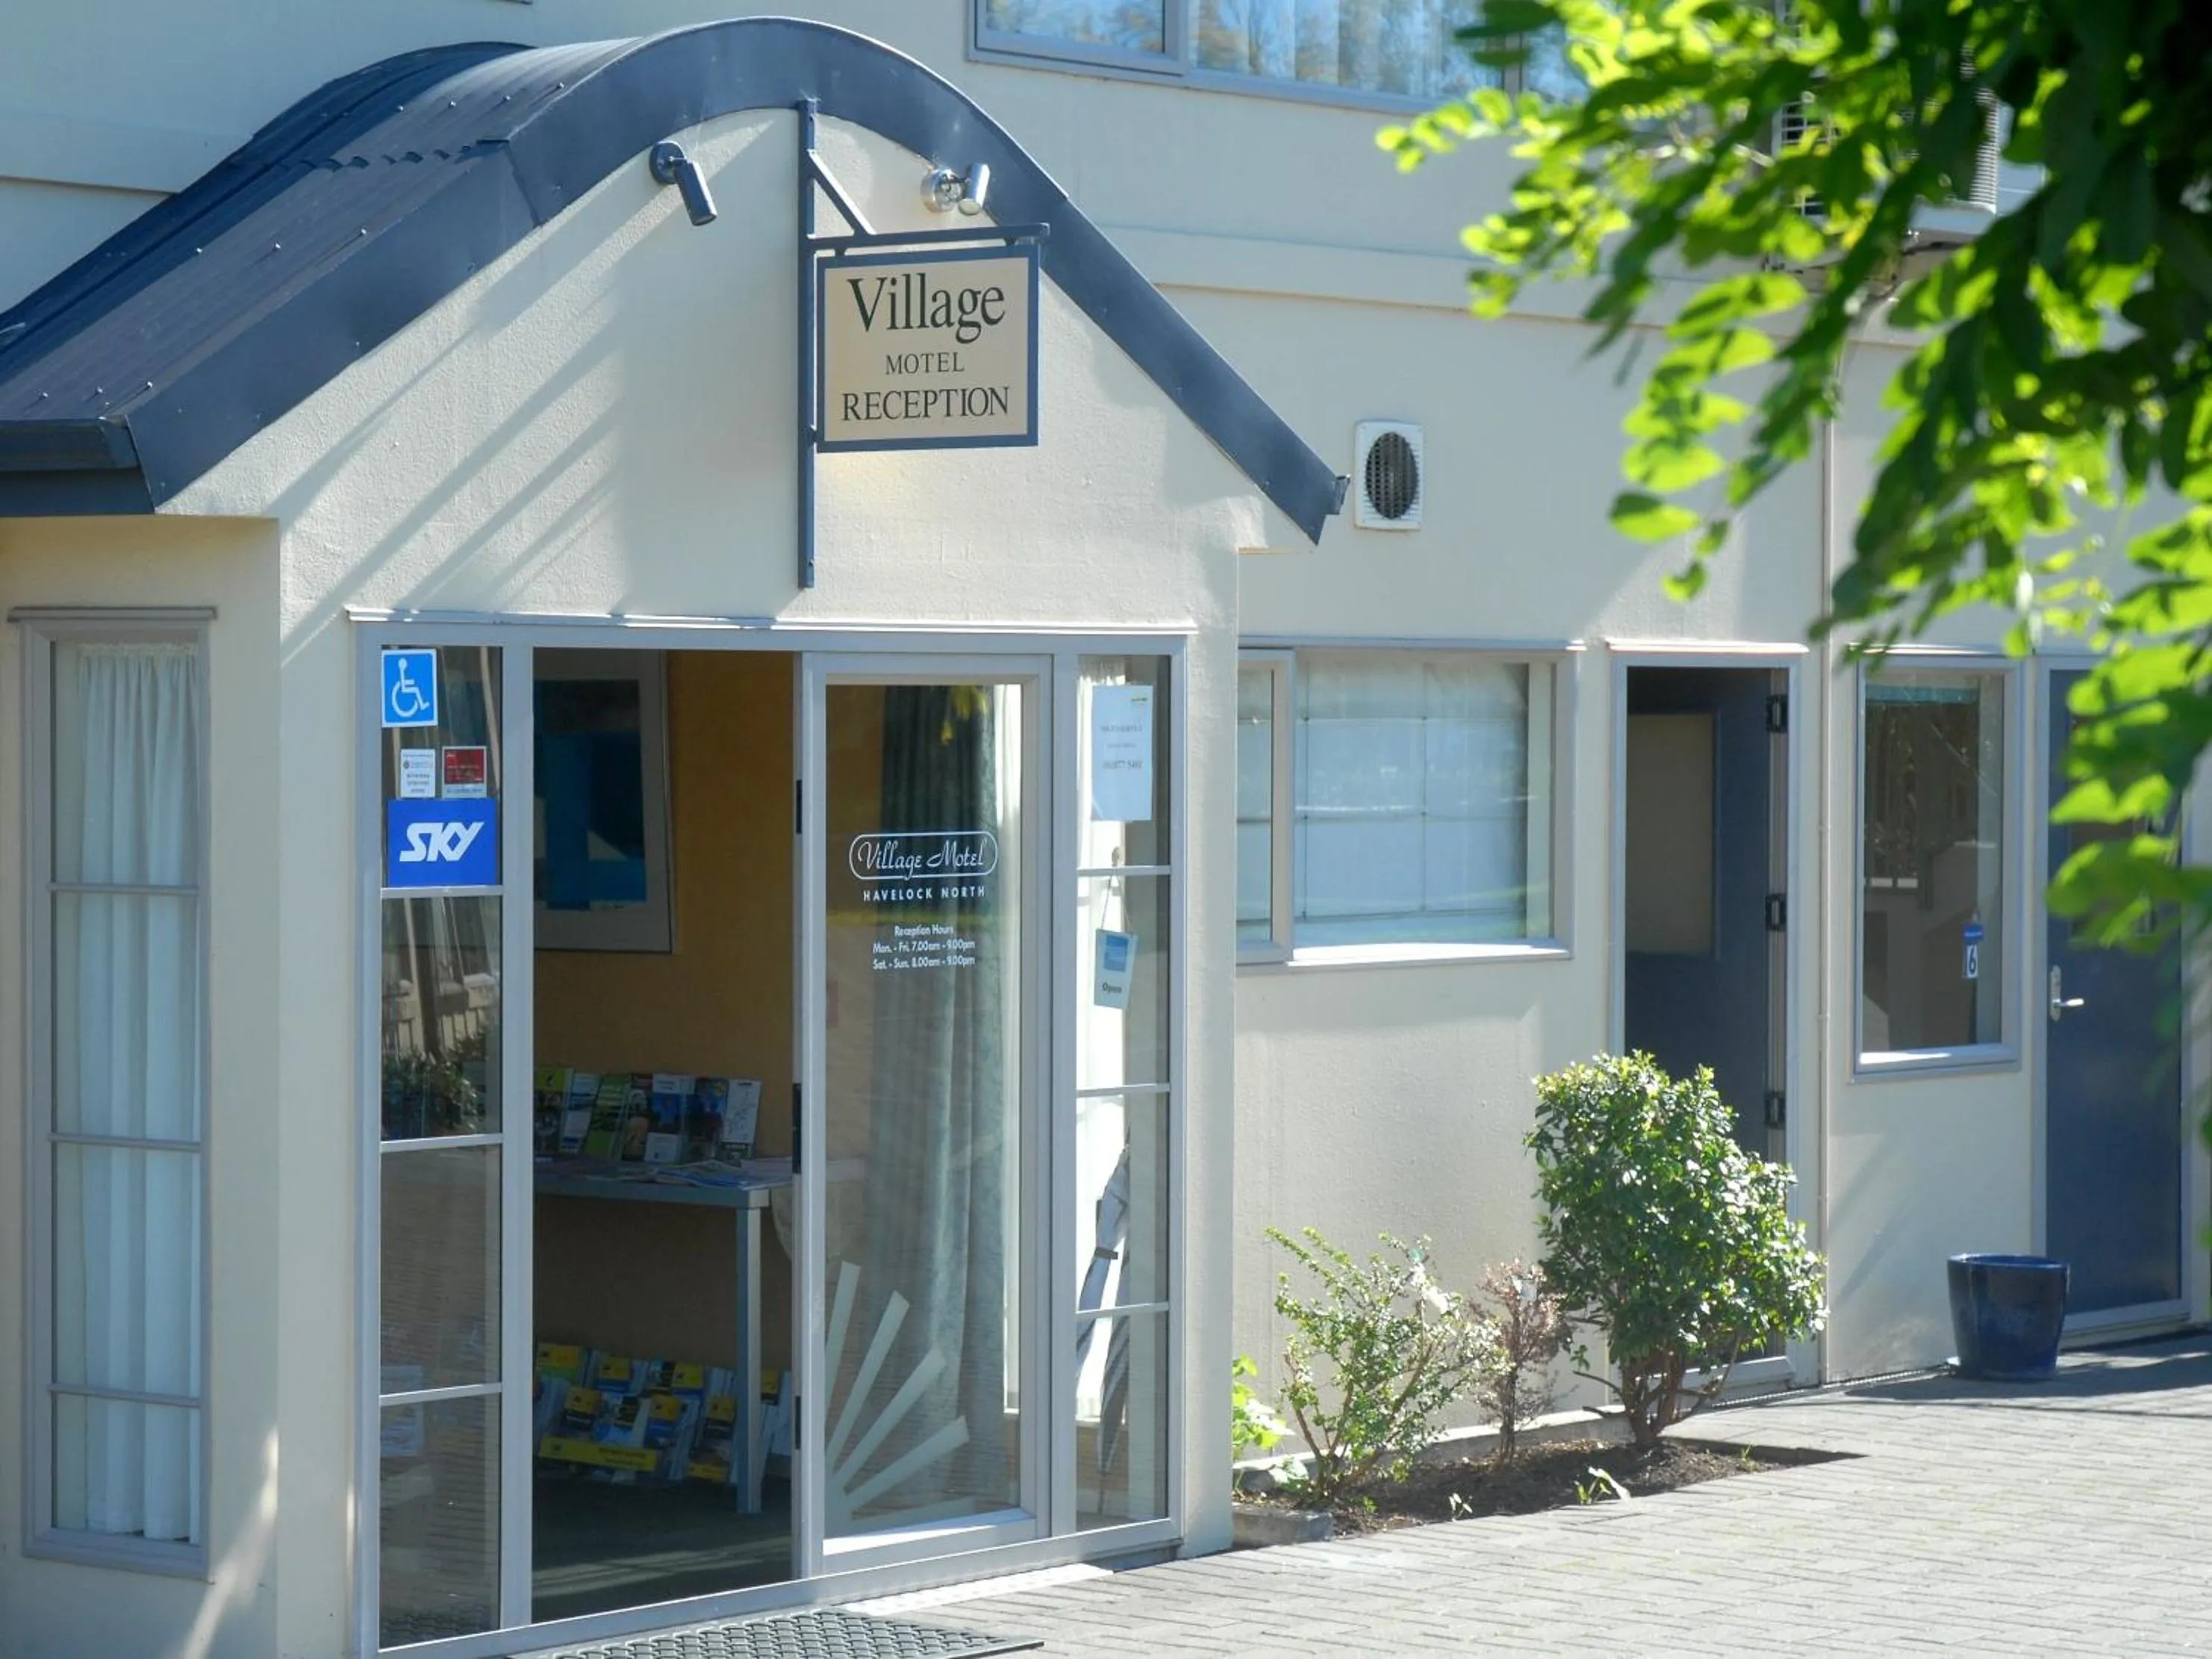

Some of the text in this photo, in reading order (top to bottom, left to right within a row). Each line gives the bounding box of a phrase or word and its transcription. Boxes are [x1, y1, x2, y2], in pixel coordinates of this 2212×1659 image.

[847, 273, 1005, 343] Village
[885, 352, 965, 375] MOTEL
[842, 386, 1009, 421] RECEPTION
[399, 822, 484, 862] SKY
[858, 836, 988, 881] Village Motel
[863, 886, 985, 902] HAVELOCK NORTH
[894, 924, 954, 938] Reception Hours
[1969, 947, 1977, 975] 6
